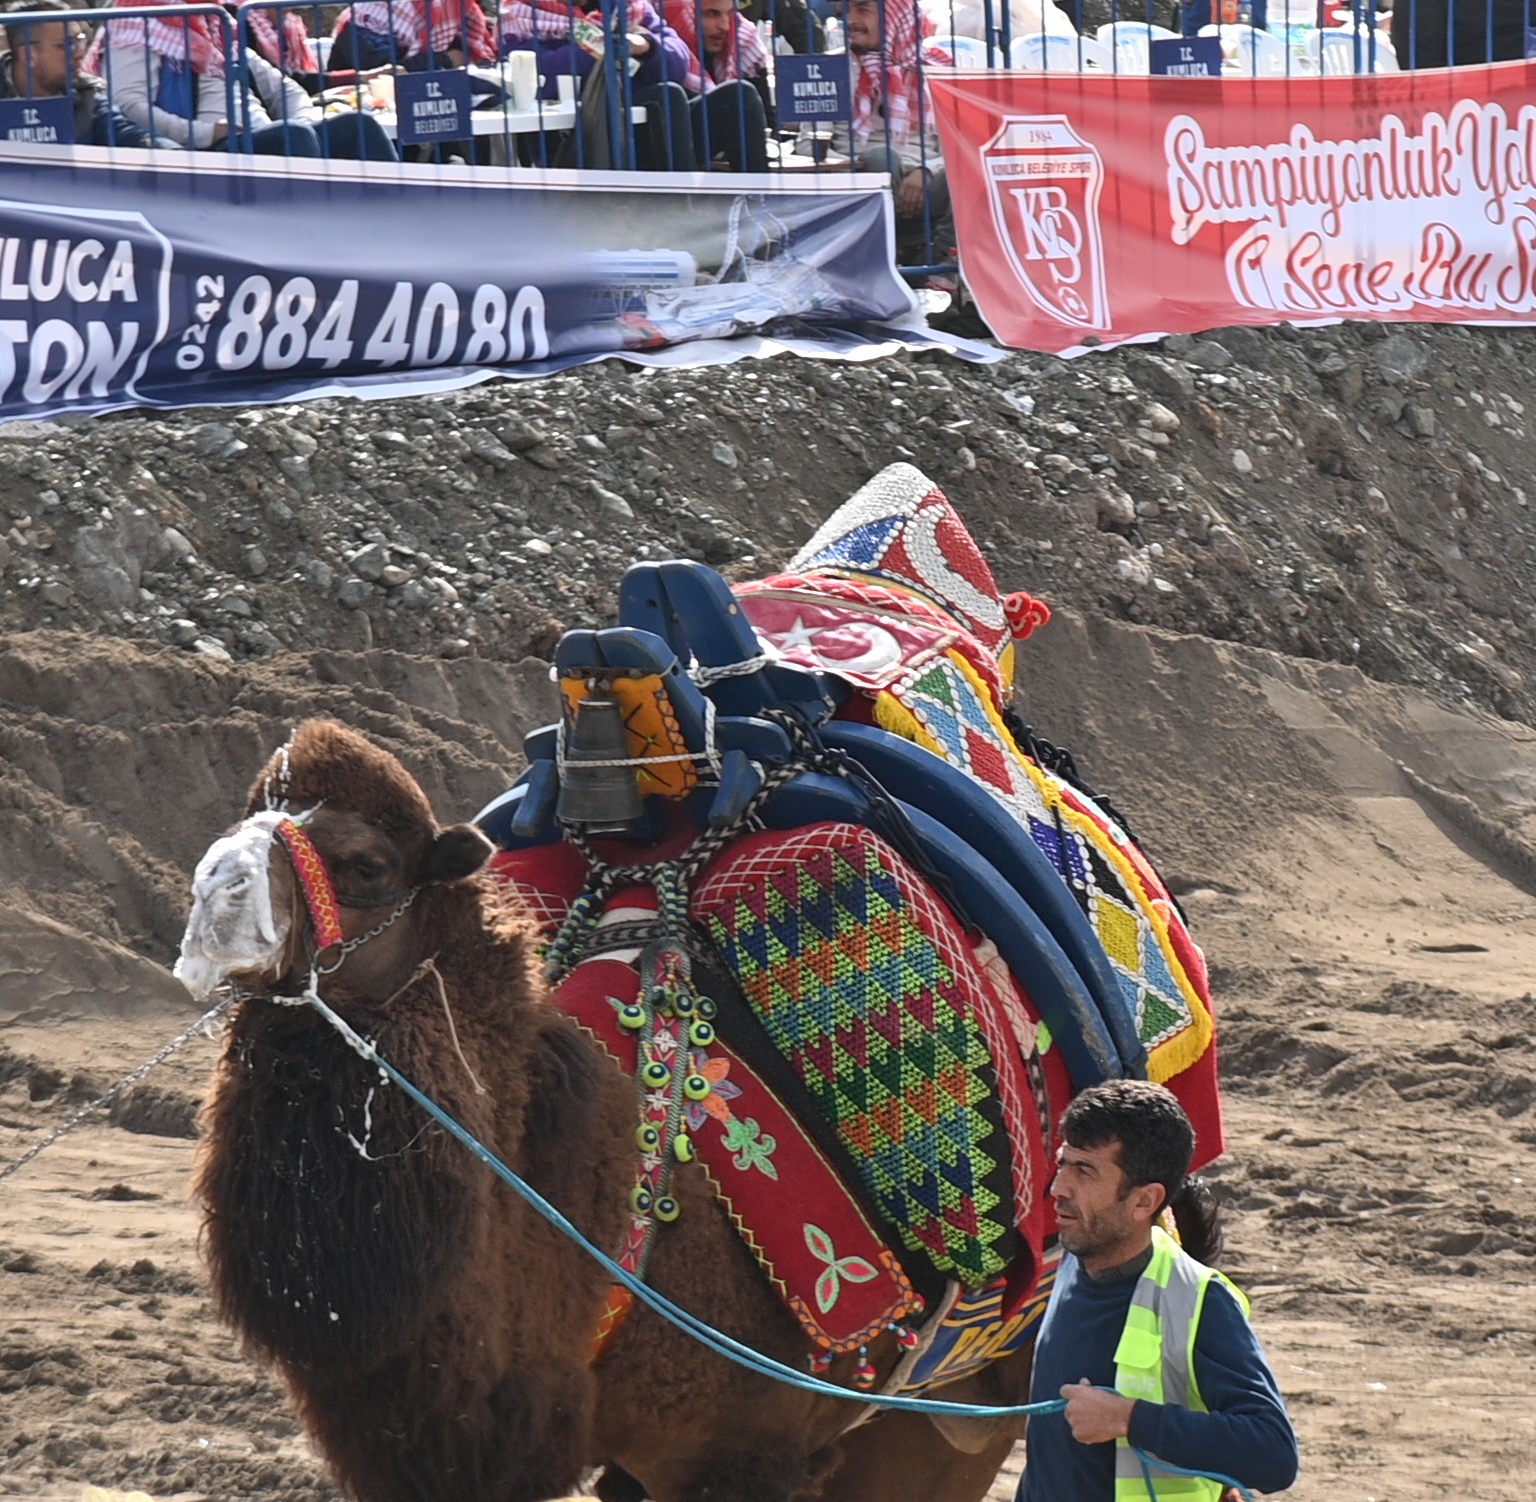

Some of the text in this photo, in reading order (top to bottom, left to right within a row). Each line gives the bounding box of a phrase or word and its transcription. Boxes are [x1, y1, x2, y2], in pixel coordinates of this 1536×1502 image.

[413, 98, 458, 117] KUMLUCA
[792, 81, 838, 97] KUMLUCA
[7, 126, 59, 142] KUMLUCA
[1173, 124, 1461, 238] Şampiyonluk
[1283, 231, 1401, 310] Sene
[1403, 221, 1487, 302] Bu
[175, 274, 225, 370] 0242
[216, 275, 360, 371] 884
